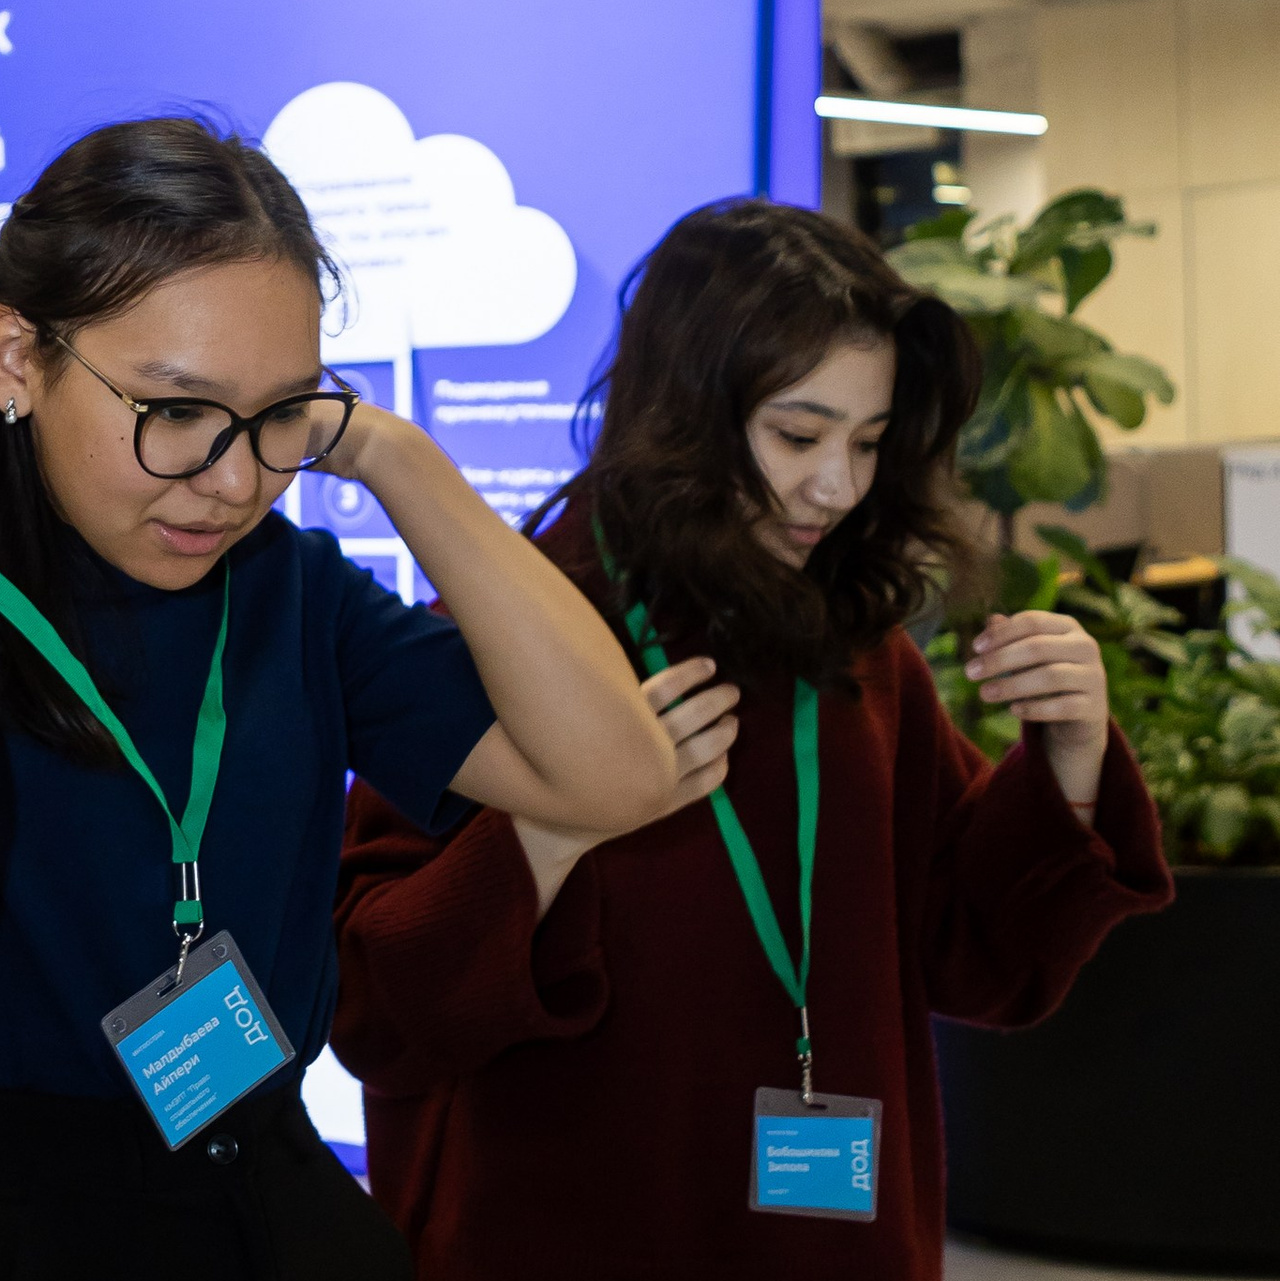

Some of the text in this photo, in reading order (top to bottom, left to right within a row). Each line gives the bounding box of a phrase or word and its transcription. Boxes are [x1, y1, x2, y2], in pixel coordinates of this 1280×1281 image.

[224, 984, 268, 1046] ДОД
[143, 1017, 220, 1078] Малдыбаева
[153, 1054, 201, 1096] Айпери
[851, 1139, 871, 1191] ДОД
